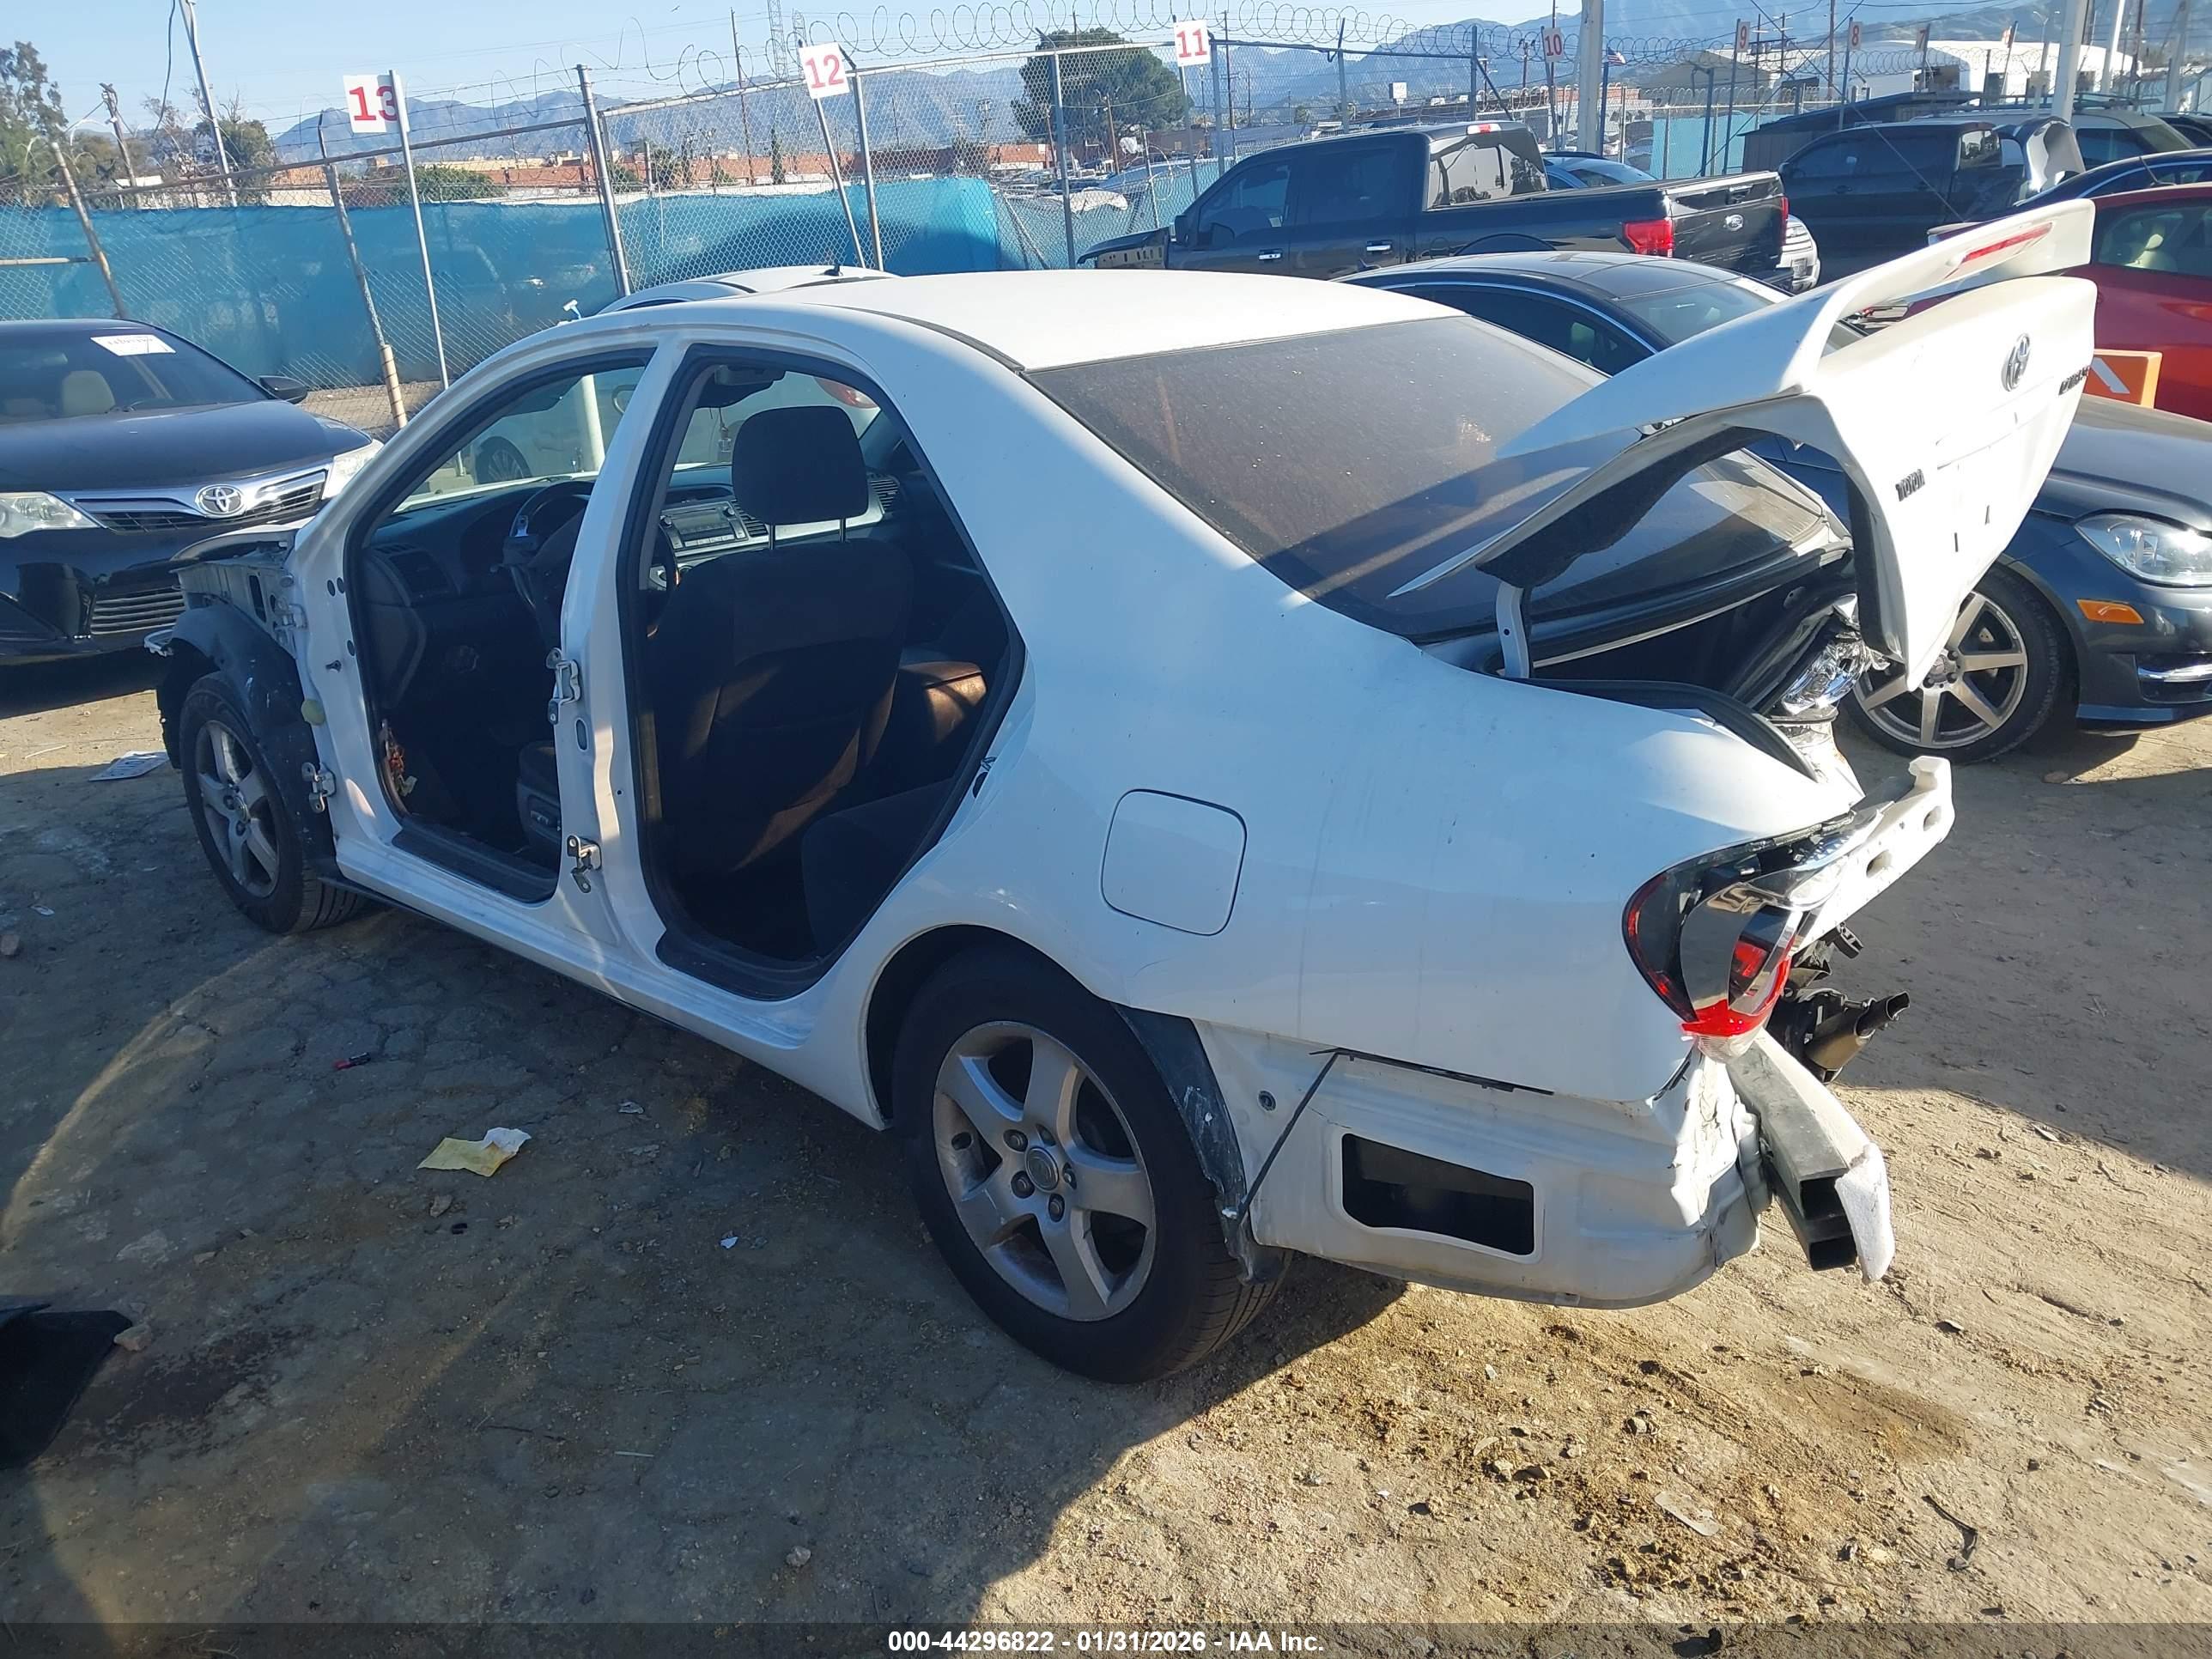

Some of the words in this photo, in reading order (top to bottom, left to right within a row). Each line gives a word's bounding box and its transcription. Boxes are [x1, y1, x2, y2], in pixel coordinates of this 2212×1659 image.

[1176, 28, 1207, 58] 11
[1545, 34, 1562, 56] 10
[1740, 25, 1747, 49] 9
[1851, 25, 1860, 46] 8
[805, 54, 844, 88] 12
[349, 86, 398, 122] 13
